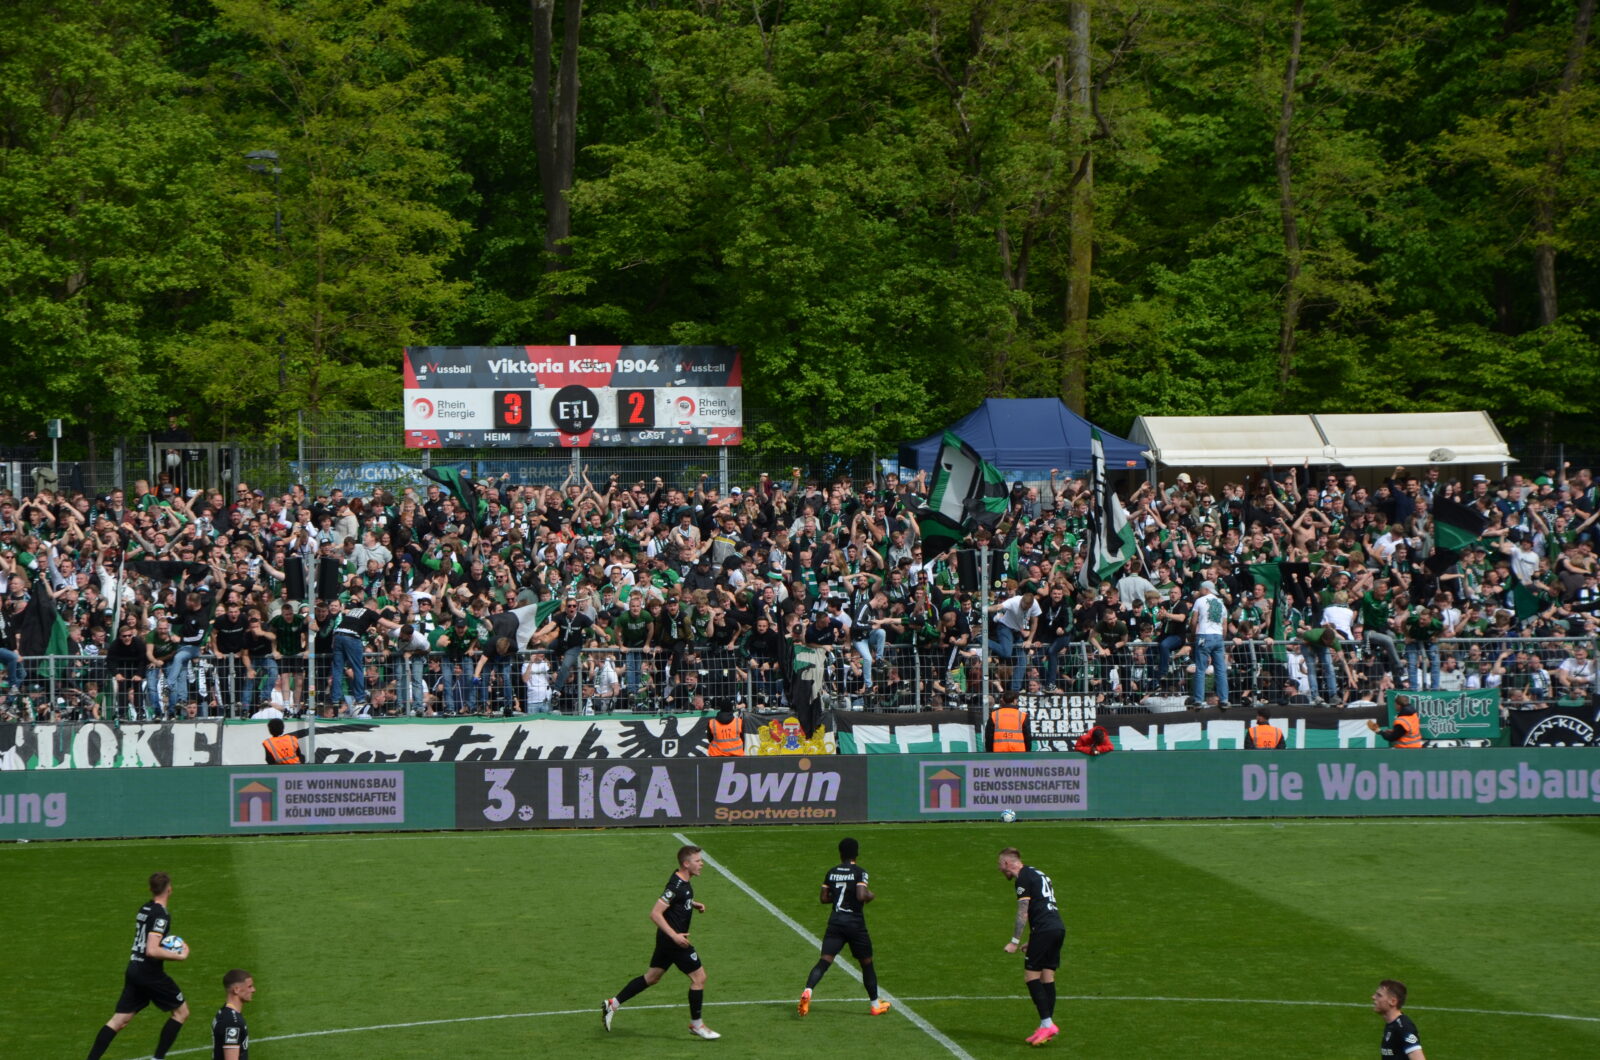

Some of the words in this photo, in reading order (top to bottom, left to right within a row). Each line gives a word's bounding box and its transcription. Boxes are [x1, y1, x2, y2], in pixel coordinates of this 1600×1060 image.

[420, 362, 472, 374] #Vussball
[488, 358, 564, 374] Viktoria
[616, 358, 660, 373] 1904
[437, 400, 466, 409] Rhein
[504, 393, 522, 425] 3
[628, 391, 646, 424] 2
[699, 398, 727, 408] Rhein
[437, 410, 476, 420] Energie
[699, 408, 736, 418] Energie
[483, 432, 511, 441] HEIM
[1030, 719, 1096, 733] ERBOT
[973, 767, 991, 778] DIE
[994, 766, 1080, 778] WOHNUNGSBAU
[285, 780, 303, 790] DIE
[306, 778, 396, 790] WOHNUNGSBAU
[715, 758, 841, 804] bwin
[973, 780, 1080, 791] GENOSSENSCHAFTEN
[1242, 764, 1303, 800] Die
[285, 792, 396, 804] GENOSSENSCHAFTEN
[482, 768, 534, 821] 3.
[548, 765, 682, 820] LIGA
[973, 792, 998, 805] KÖLN
[1001, 794, 1022, 804] UND
[1025, 793, 1080, 805] UMGEBUNG
[285, 805, 310, 818] KÖLN
[313, 806, 336, 817] UND
[339, 805, 396, 817] UMGEBUNG
[714, 807, 837, 821] Sportwetten
[835, 882, 847, 907] 7
